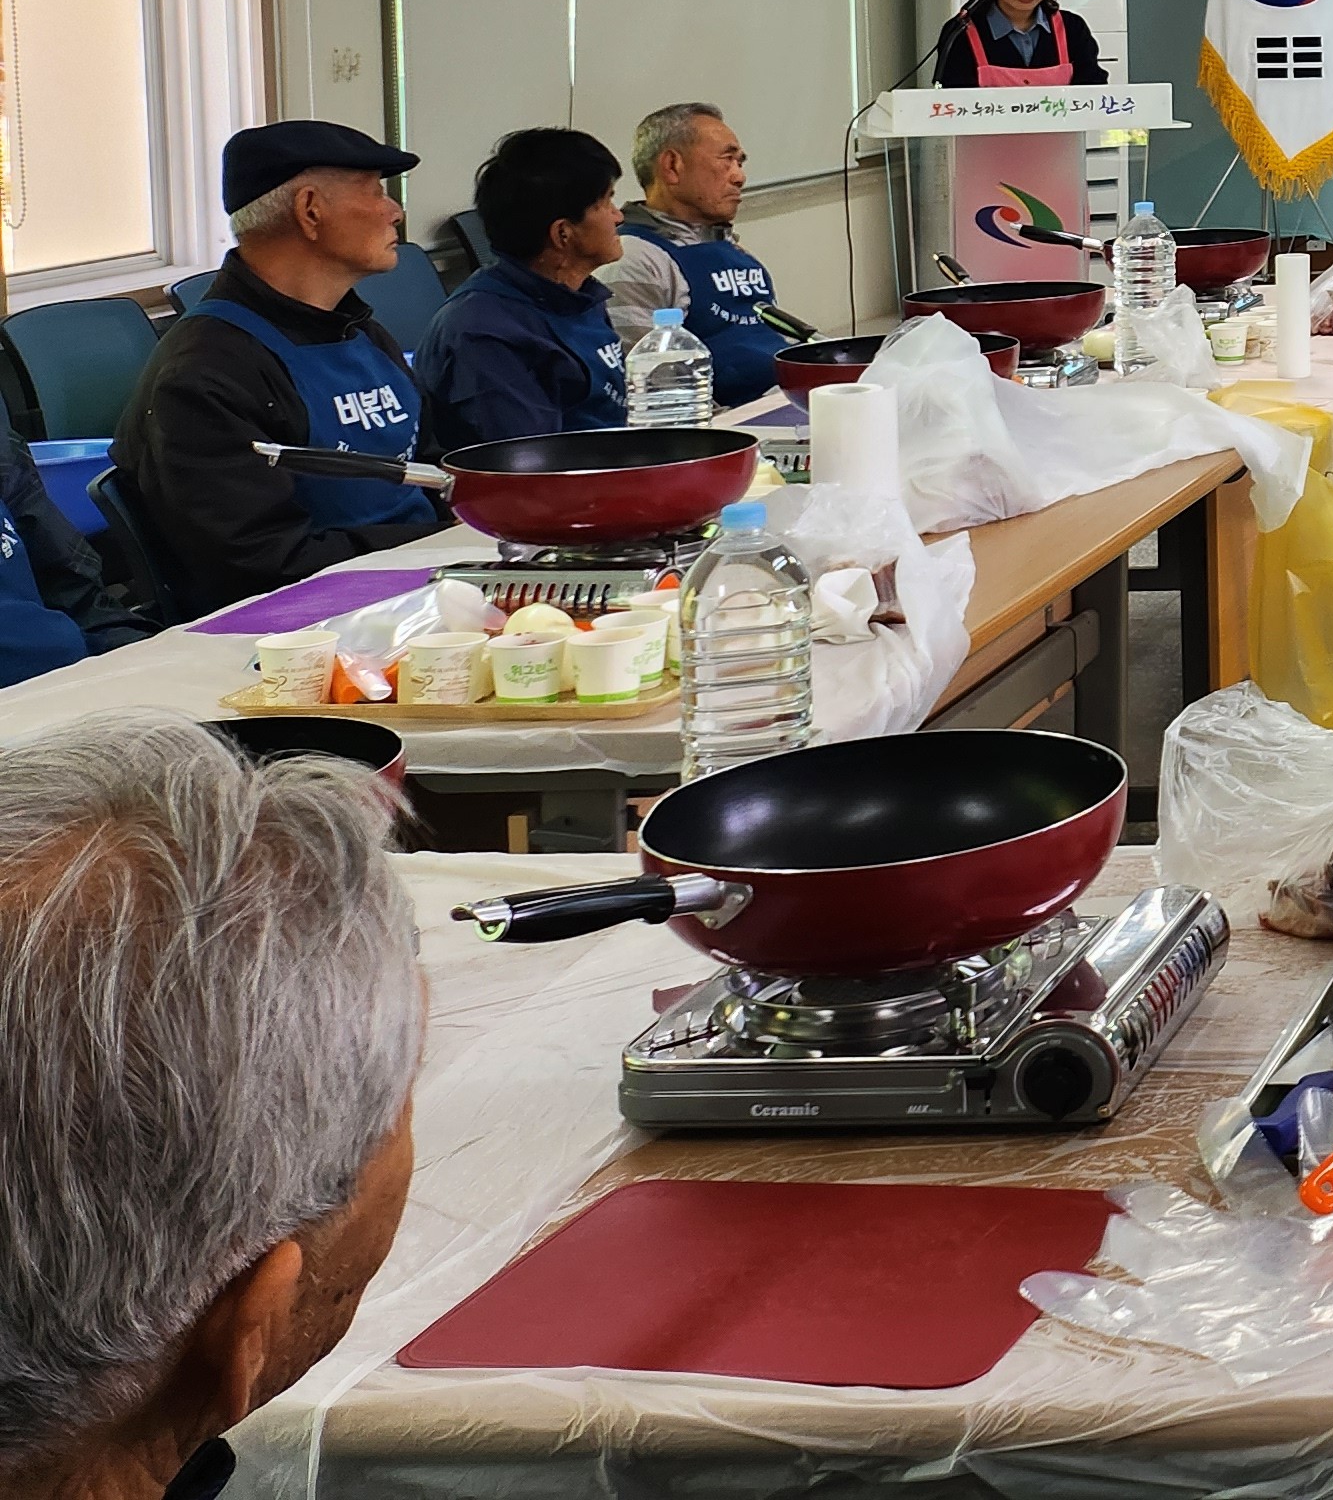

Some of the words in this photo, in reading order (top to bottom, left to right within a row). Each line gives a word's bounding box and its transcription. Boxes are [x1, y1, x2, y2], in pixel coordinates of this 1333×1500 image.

[929, 102, 968, 118] 모두가
[972, 101, 1006, 117] 누리는
[1099, 95, 1136, 115] 완주
[711, 268, 770, 297] 비봉면
[334, 384, 409, 431] 비봉면
[751, 1102, 820, 1118] Ceramic
